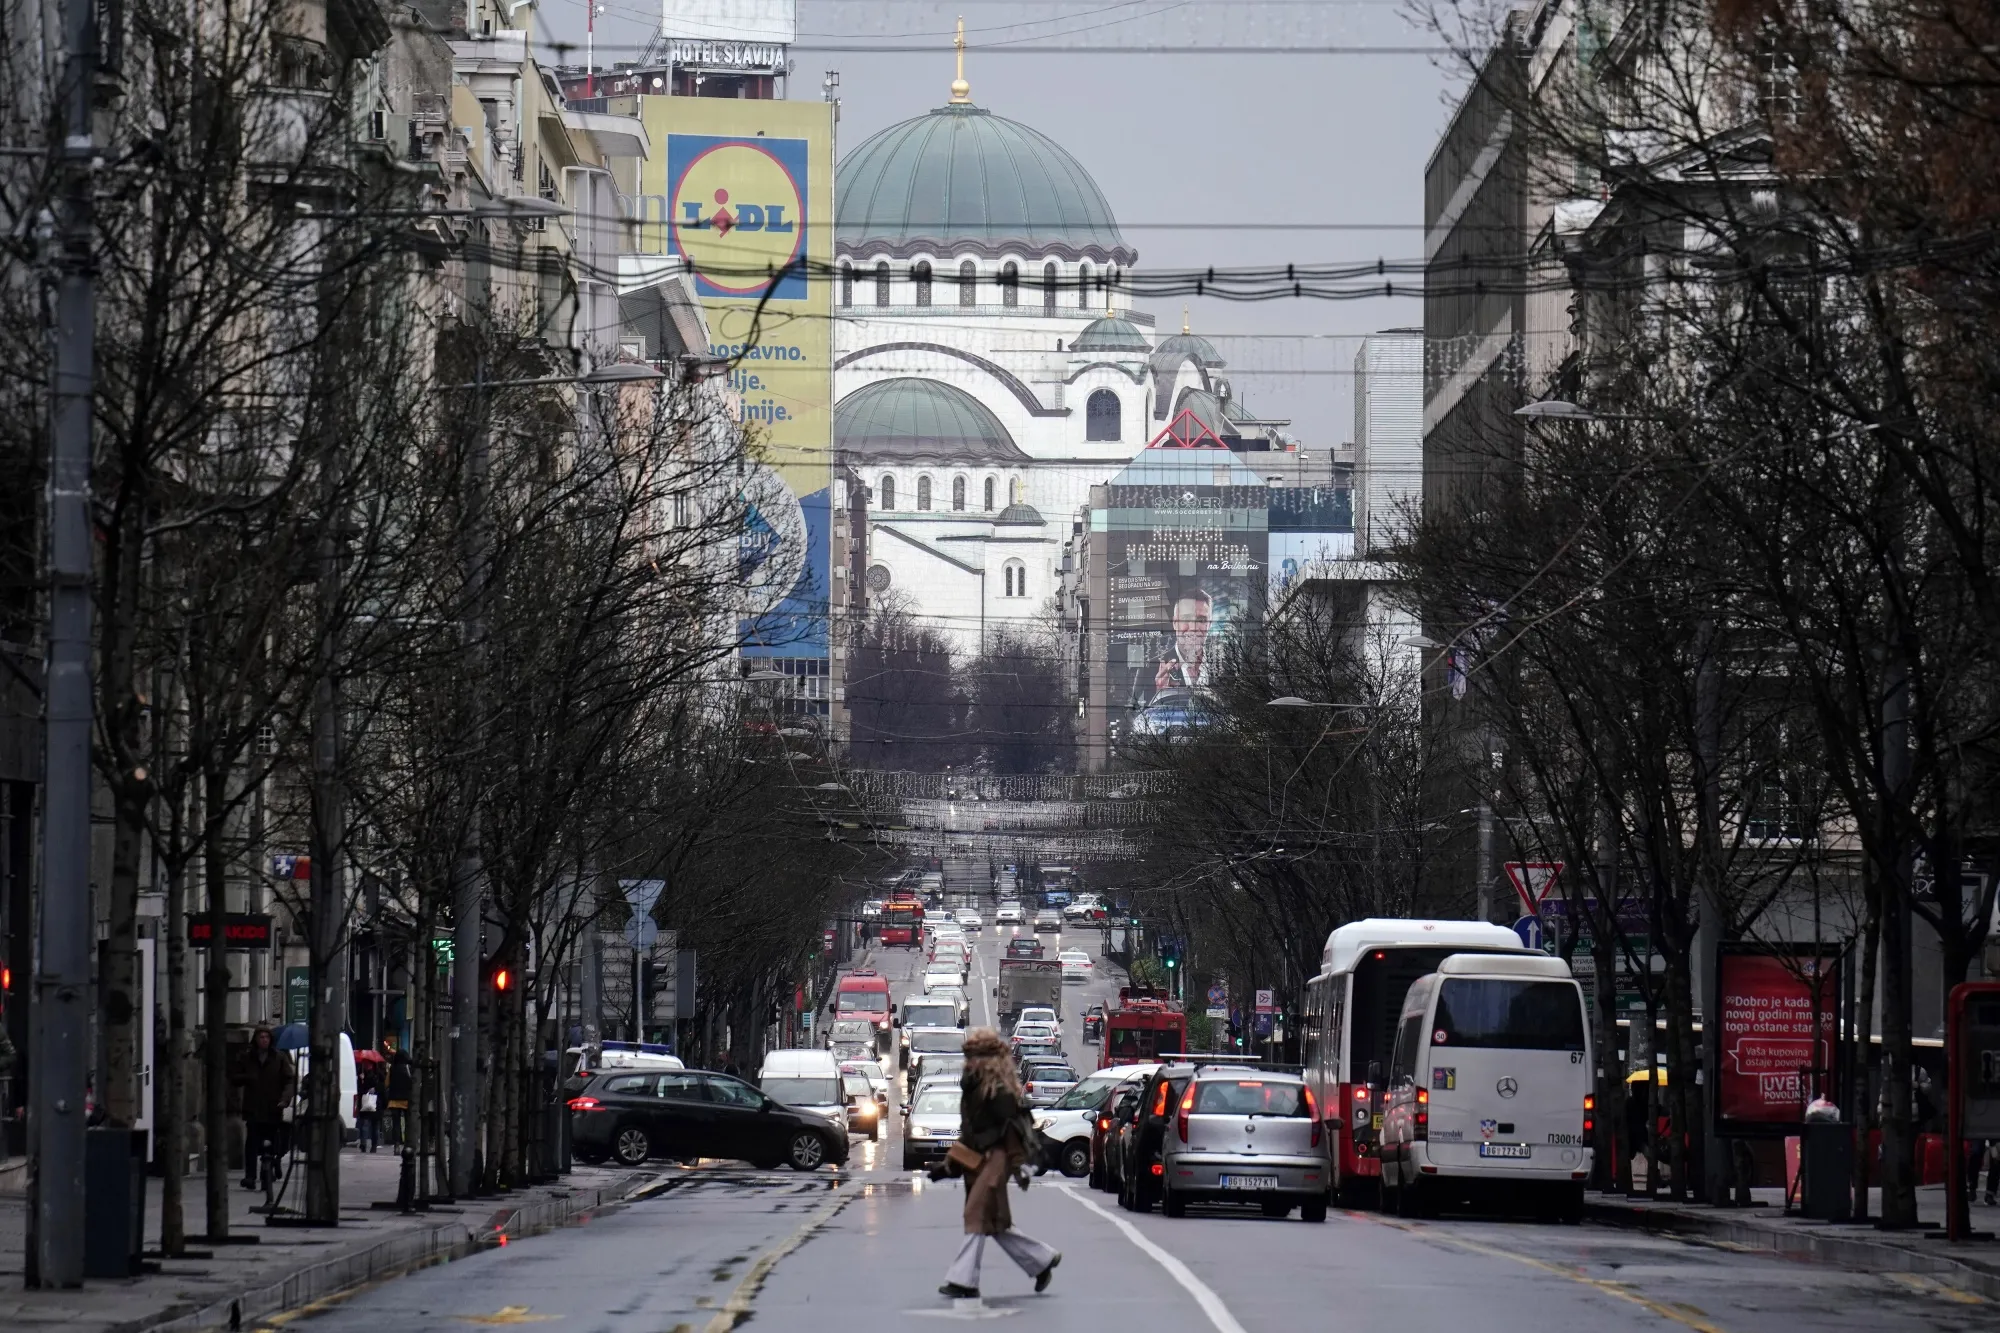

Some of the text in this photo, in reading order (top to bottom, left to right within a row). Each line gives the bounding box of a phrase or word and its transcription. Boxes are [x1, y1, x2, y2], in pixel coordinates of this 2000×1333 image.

[671, 43, 784, 66] HOTEL SLAVIJA
[1152, 519, 1224, 542] NAJVEĆA
[1126, 544, 1250, 562] NAGRADNA IGRA
[1221, 561, 1260, 571] Balkanu
[1770, 997, 1782, 1010] je
[1784, 995, 1811, 1008] kada
[1725, 1008, 1833, 1023] novoj godini mngo
[1725, 1022, 1750, 1034] toga
[1753, 1022, 1790, 1032] ostane
[1435, 1032, 1445, 1041] 50
[1570, 1052, 1584, 1064] 67
[1745, 1046, 1808, 1060] Vaša kupovina
[1745, 1057, 1772, 1069] ostaje
[1486, 1145, 1498, 1156] BG
[1228, 1176, 1238, 1186] BG
